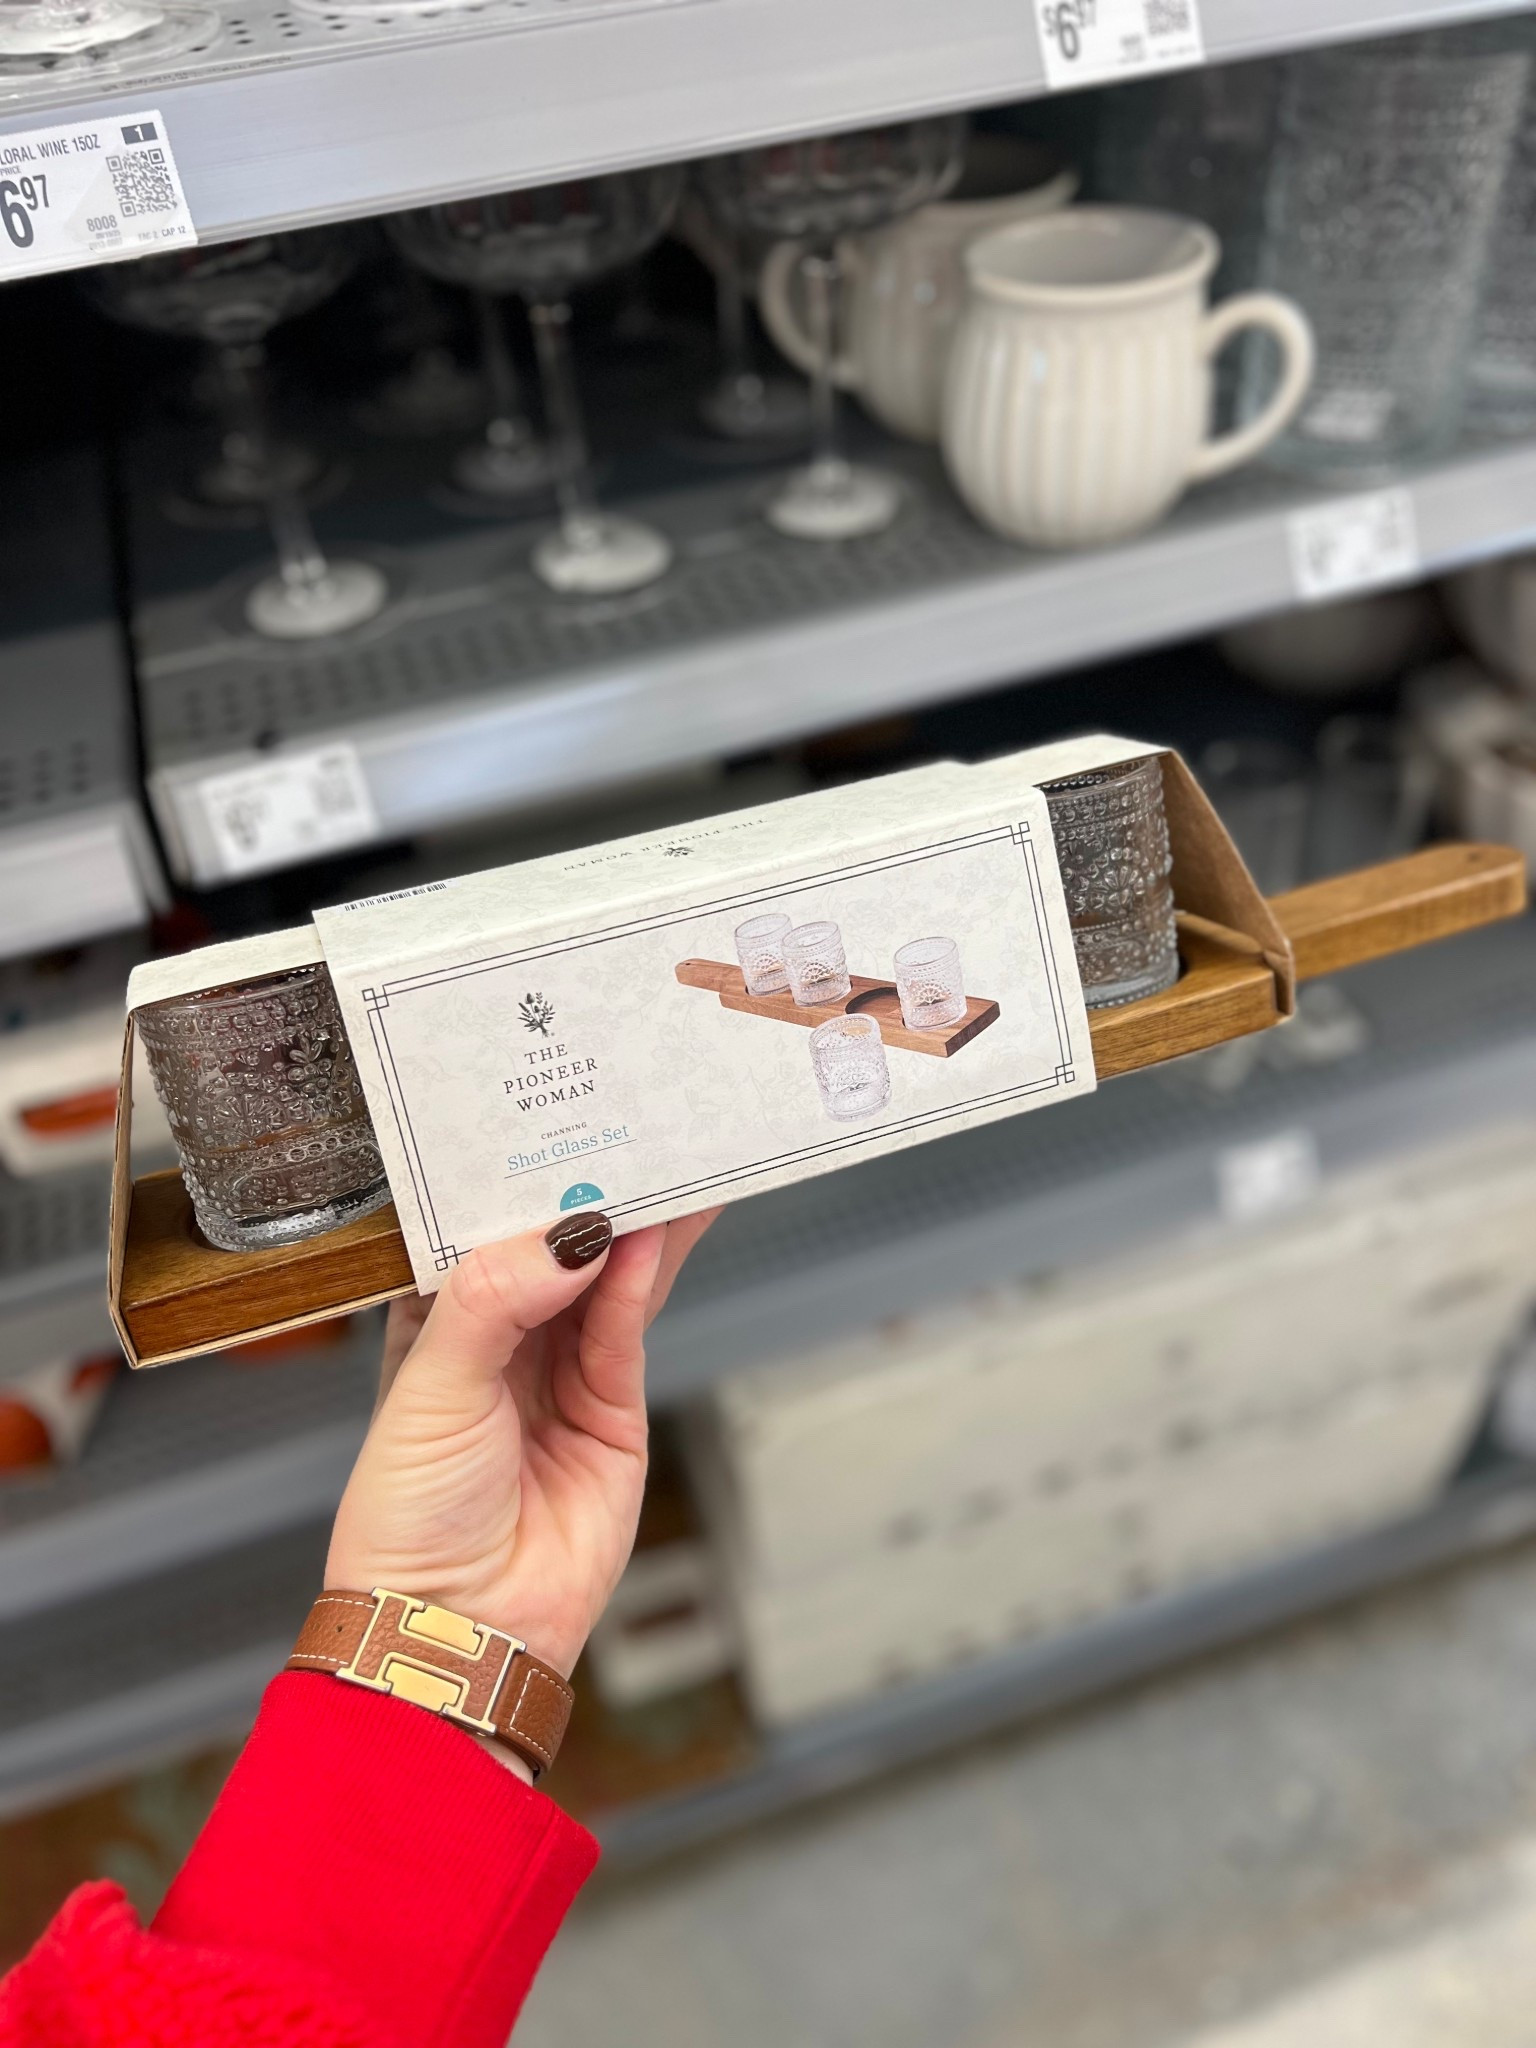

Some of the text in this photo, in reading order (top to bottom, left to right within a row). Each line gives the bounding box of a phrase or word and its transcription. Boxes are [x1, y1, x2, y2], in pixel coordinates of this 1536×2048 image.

[134, 125, 145, 141] 1
[37, 139, 70, 158] WINE
[72, 134, 101, 152] 15OZ
[86, 214, 118, 232] 8008
[161, 227, 175, 237] CAP
[177, 225, 187, 234] 12
[563, 819, 768, 871] THE PIONEER WOMAN
[524, 1043, 568, 1065] THE
[503, 1057, 598, 1094] PIONEER
[517, 1079, 595, 1112] WOMAN
[540, 1121, 588, 1140] CHANNING
[507, 1124, 629, 1171] Shot Glass Set
[570, 1195, 592, 1205] PIECES
[576, 1187, 583, 1196] 5
